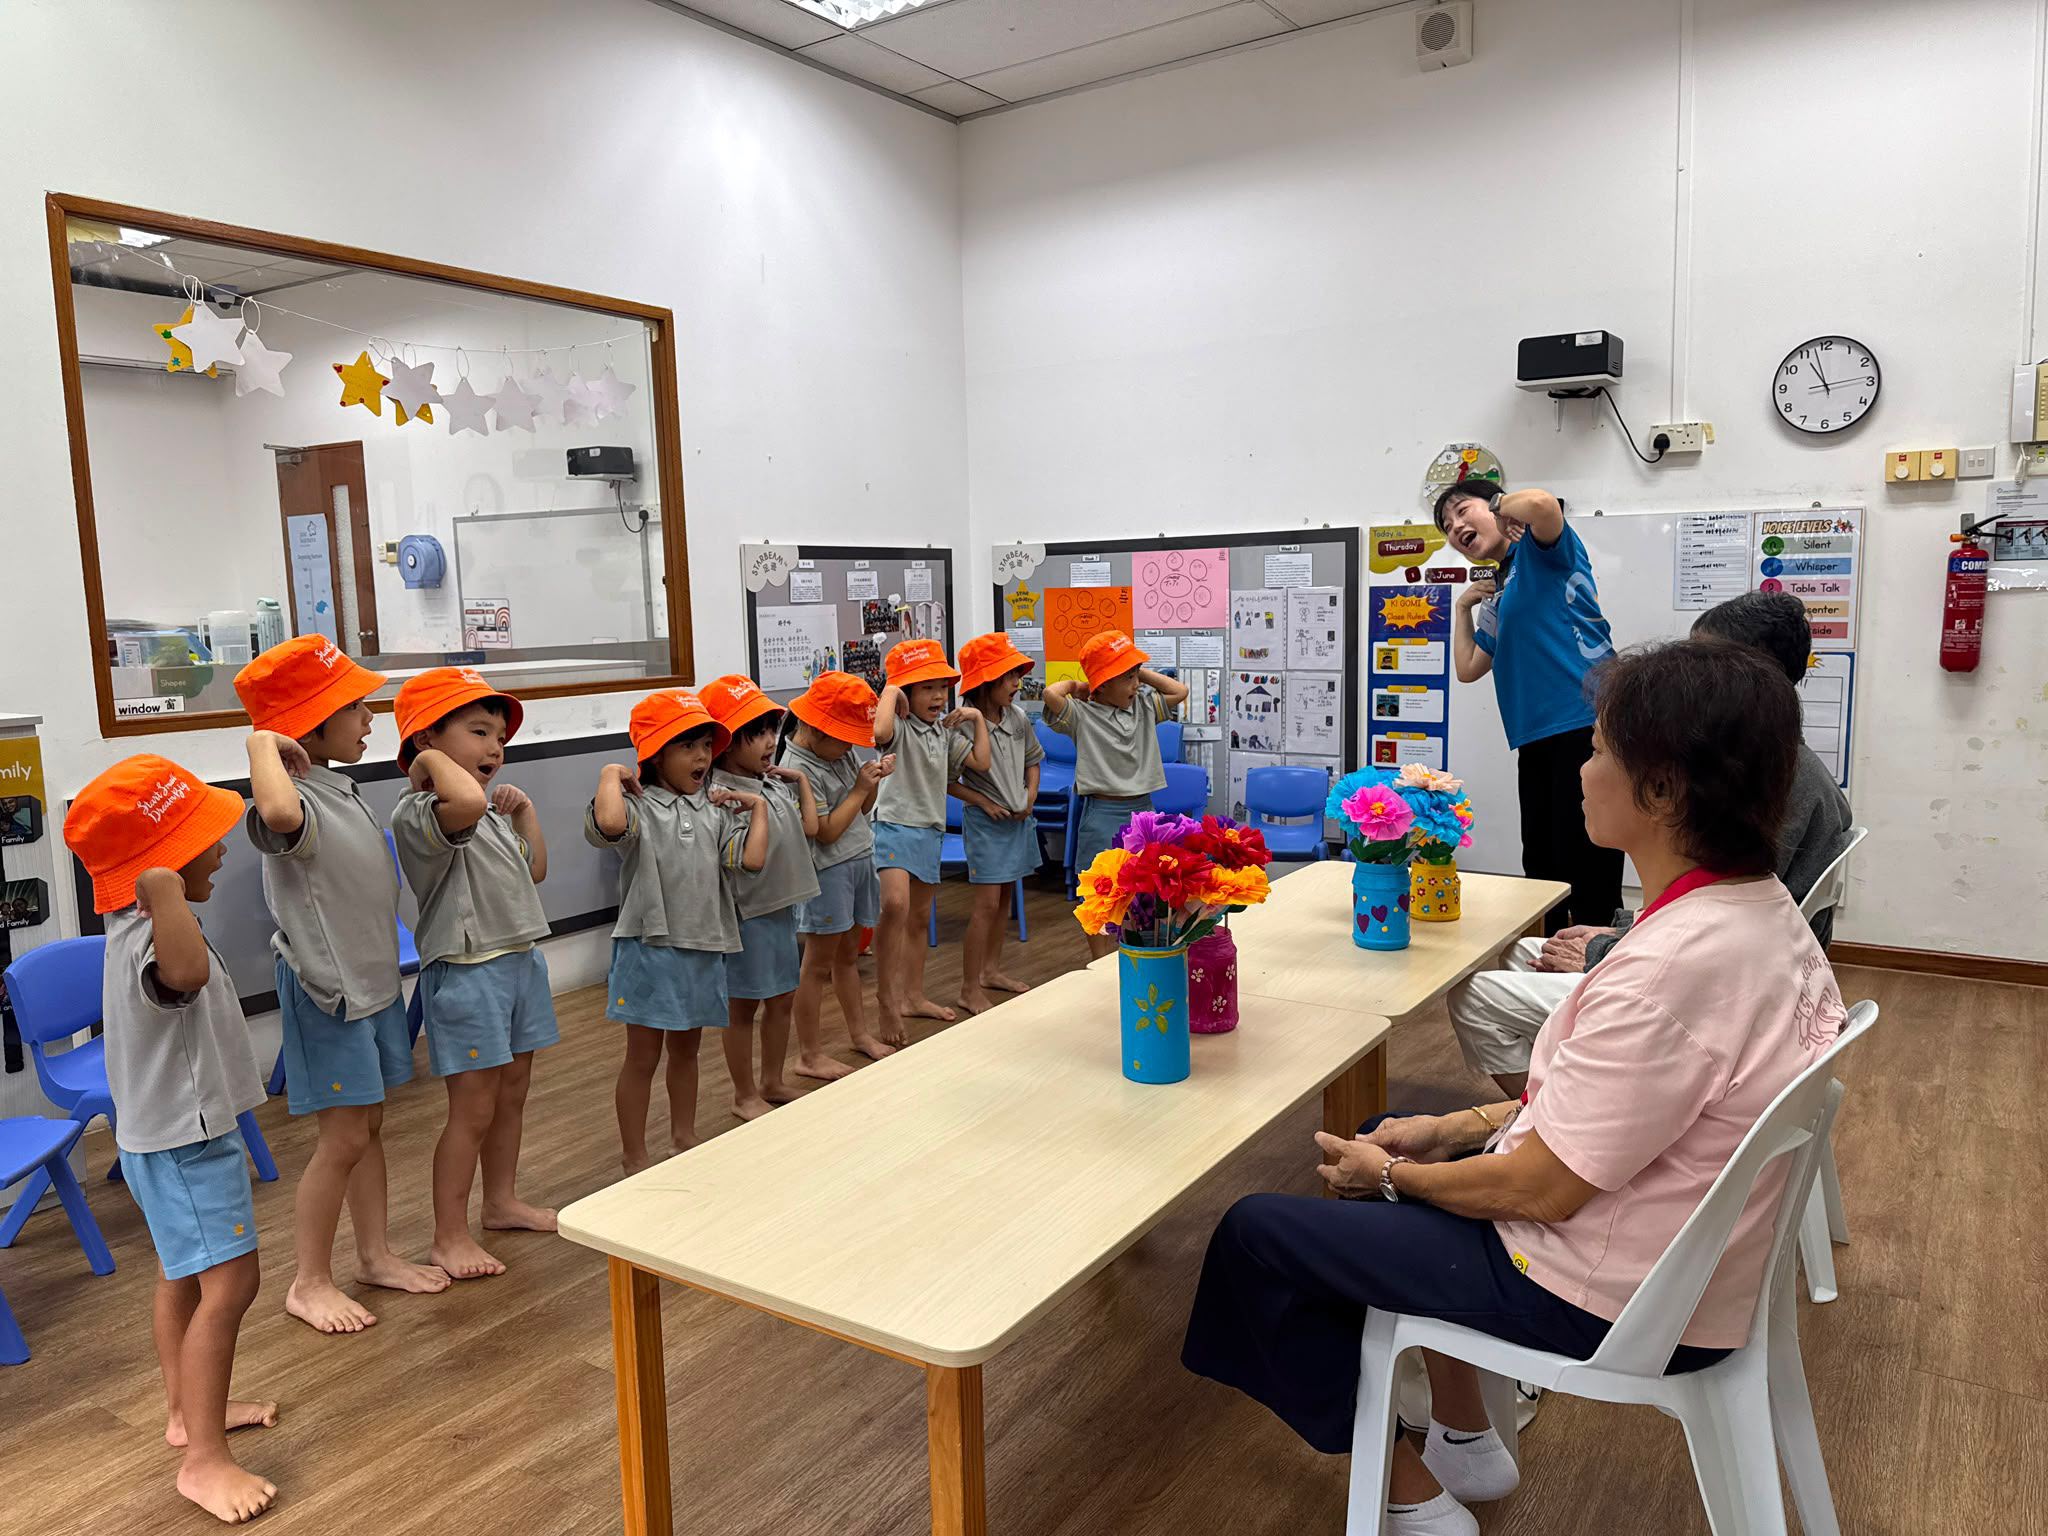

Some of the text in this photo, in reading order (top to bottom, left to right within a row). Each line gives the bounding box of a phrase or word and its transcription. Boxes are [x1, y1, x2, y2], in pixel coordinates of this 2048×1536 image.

[1820, 340, 1833, 351] 12
[1847, 345, 1851, 354] 1
[1800, 349, 1810, 359] 11
[1860, 357, 1870, 367] 2
[1785, 364, 1798, 375] 10
[1866, 376, 1875, 386] 3
[1779, 384, 1788, 394] 9
[1859, 396, 1867, 406] 4
[1784, 403, 1792, 412] 8
[1800, 415, 1807, 425] 7
[1843, 412, 1852, 422] 5
[1820, 419, 1829, 429] 6
[1761, 519, 1832, 535] VOICE LEVELS
[1385, 543, 1418, 551] Thursday
[1803, 539, 1832, 549] Silent
[752, 551, 783, 576] STARBEAM
[999, 550, 1030, 572] STARBEAM
[1795, 562, 1838, 573] Whisper
[1473, 569, 1493, 578] 2026
[1790, 582, 1841, 593] Table Talk
[1807, 605, 1839, 614] senter
[1812, 625, 1832, 635] side
[160, 679, 186, 688] Shapes
[118, 703, 161, 715] window
[0, 760, 32, 781] mily
[136, 790, 163, 816] Start
[148, 781, 191, 824] Dream Big
[2, 835, 25, 844] Family
[6, 918, 29, 927] Family
